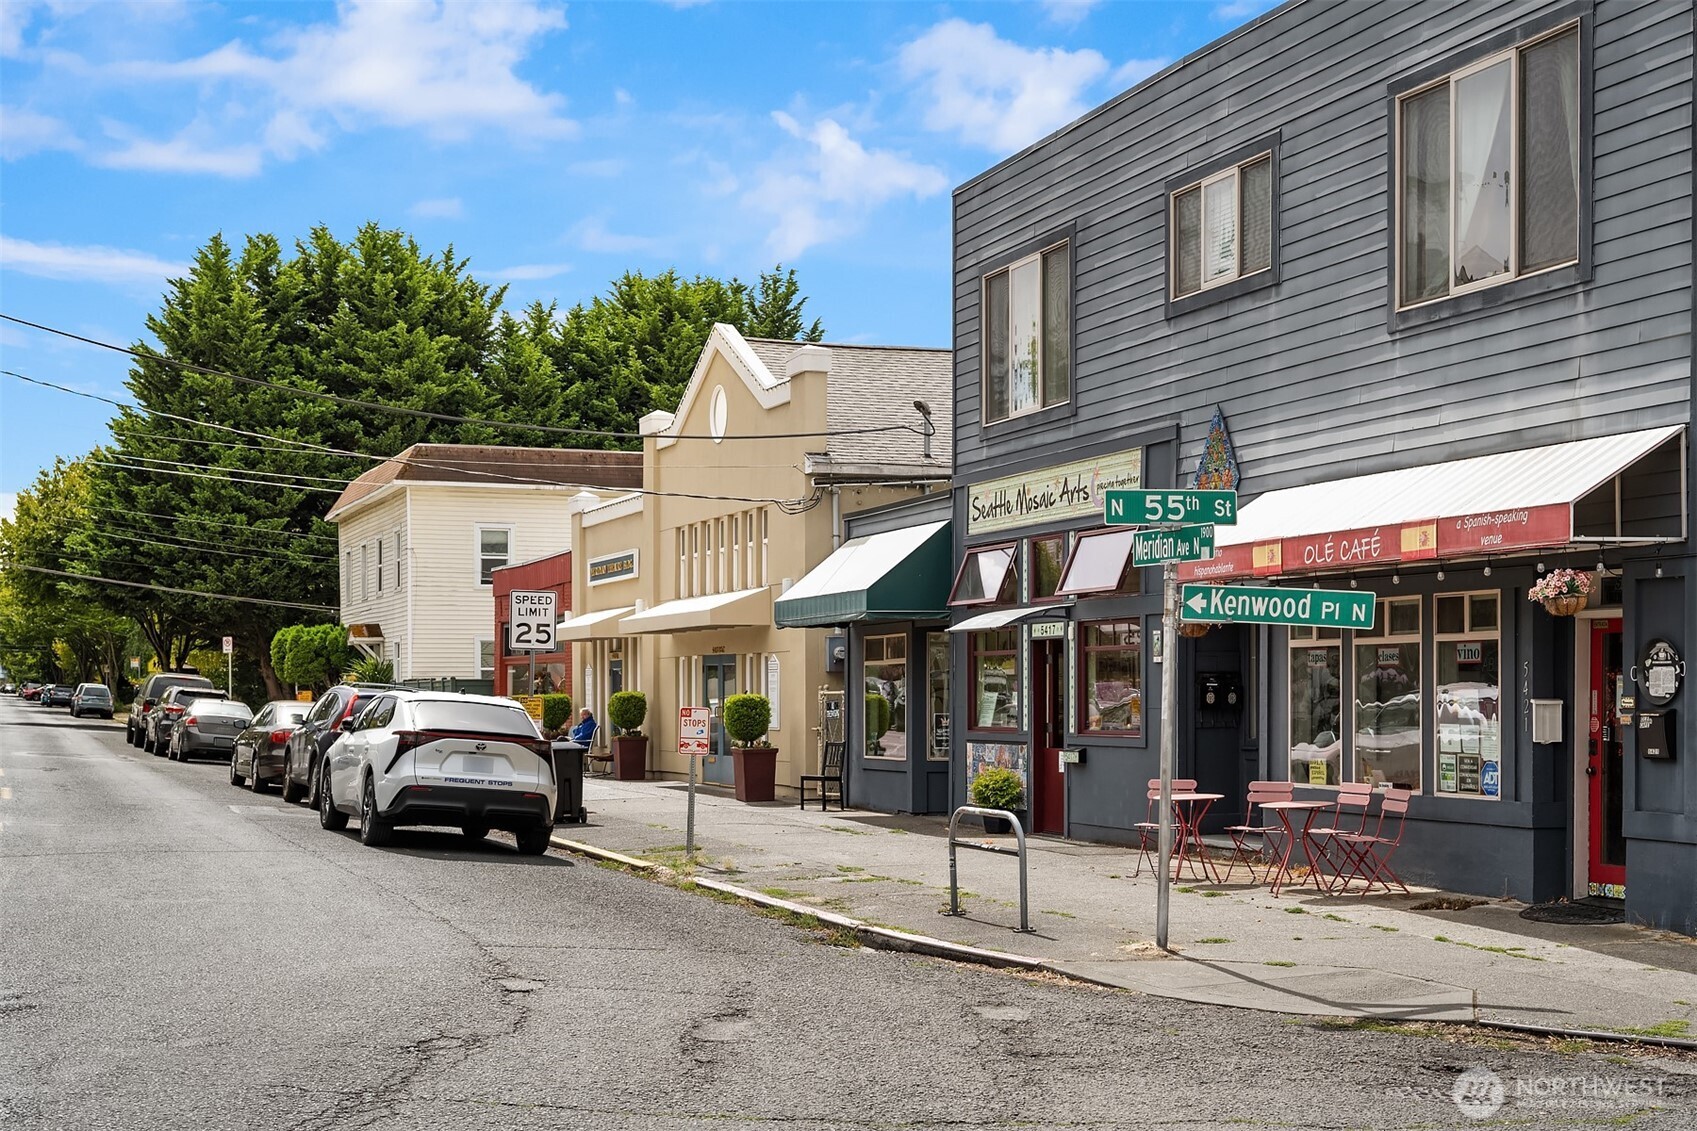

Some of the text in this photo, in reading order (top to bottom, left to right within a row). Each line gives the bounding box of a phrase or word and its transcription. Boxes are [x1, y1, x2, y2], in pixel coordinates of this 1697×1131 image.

[972, 474, 1090, 522] Seattle Mosaic Arts
[1111, 495, 1232, 520] N 55th St
[1456, 508, 1529, 532] a Spanish-speaking
[1200, 526, 1213, 539] 1900
[1480, 533, 1503, 546] venue
[1135, 533, 1174, 561] Meridian
[1176, 539, 1190, 556] Ave
[1193, 537, 1200, 555] N
[1304, 528, 1381, 565] OLÉ CAFÉ
[1194, 562, 1234, 578] hispanohablante
[515, 595, 553, 605] SPEED
[1210, 588, 1366, 622] Kenwood Pl N
[518, 607, 549, 617] LIMIT
[515, 622, 552, 644] 25
[1040, 624, 1056, 636] 5417
[1307, 652, 1327, 665] tapas
[1378, 650, 1399, 662] clases
[1457, 644, 1480, 661] vino
[683, 719, 706, 728] STOPS
[444, 777, 486, 785] FREQUENT
[488, 779, 513, 787] STOPS
[1484, 772, 1498, 784] ADT
